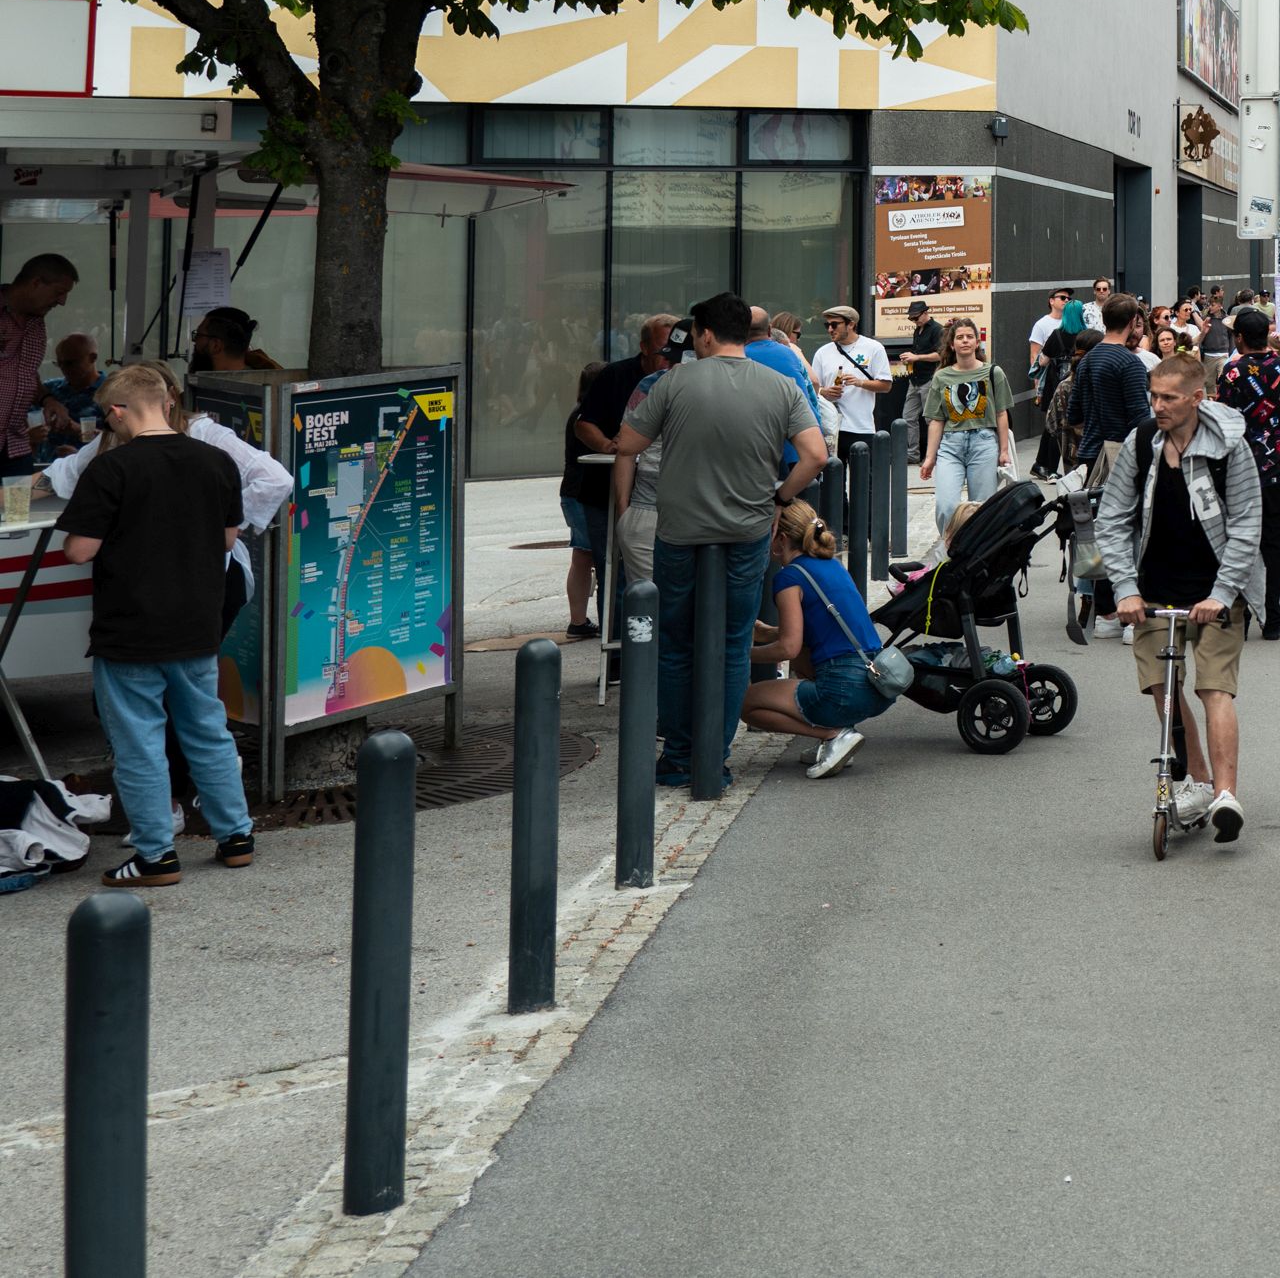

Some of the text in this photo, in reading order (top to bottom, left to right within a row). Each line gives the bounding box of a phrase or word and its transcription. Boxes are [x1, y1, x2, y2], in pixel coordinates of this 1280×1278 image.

[909, 216, 935, 224] ABEND
[890, 234, 910, 242] Tyrolean
[428, 405, 446, 413] BRUCK
[305, 411, 349, 429] BOGEN
[305, 425, 337, 442] FEST
